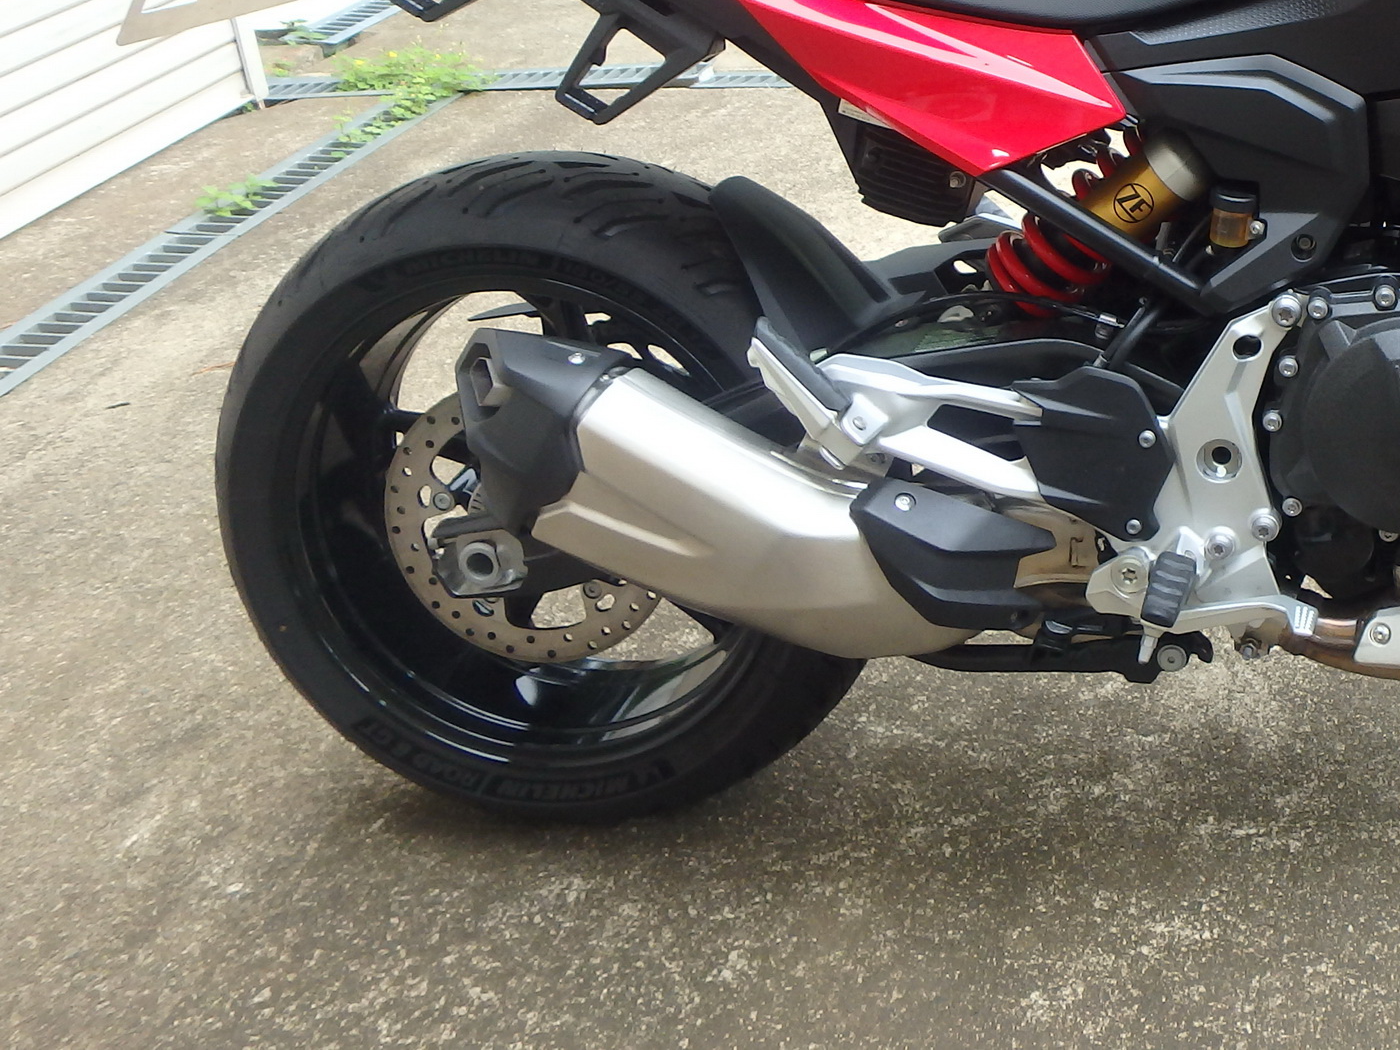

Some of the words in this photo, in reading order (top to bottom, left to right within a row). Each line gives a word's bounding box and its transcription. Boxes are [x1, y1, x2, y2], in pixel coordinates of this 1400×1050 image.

[1115, 183, 1153, 221] ZF
[404, 250, 539, 276] MICHELIN
[496, 774, 629, 800] MICHELIN
